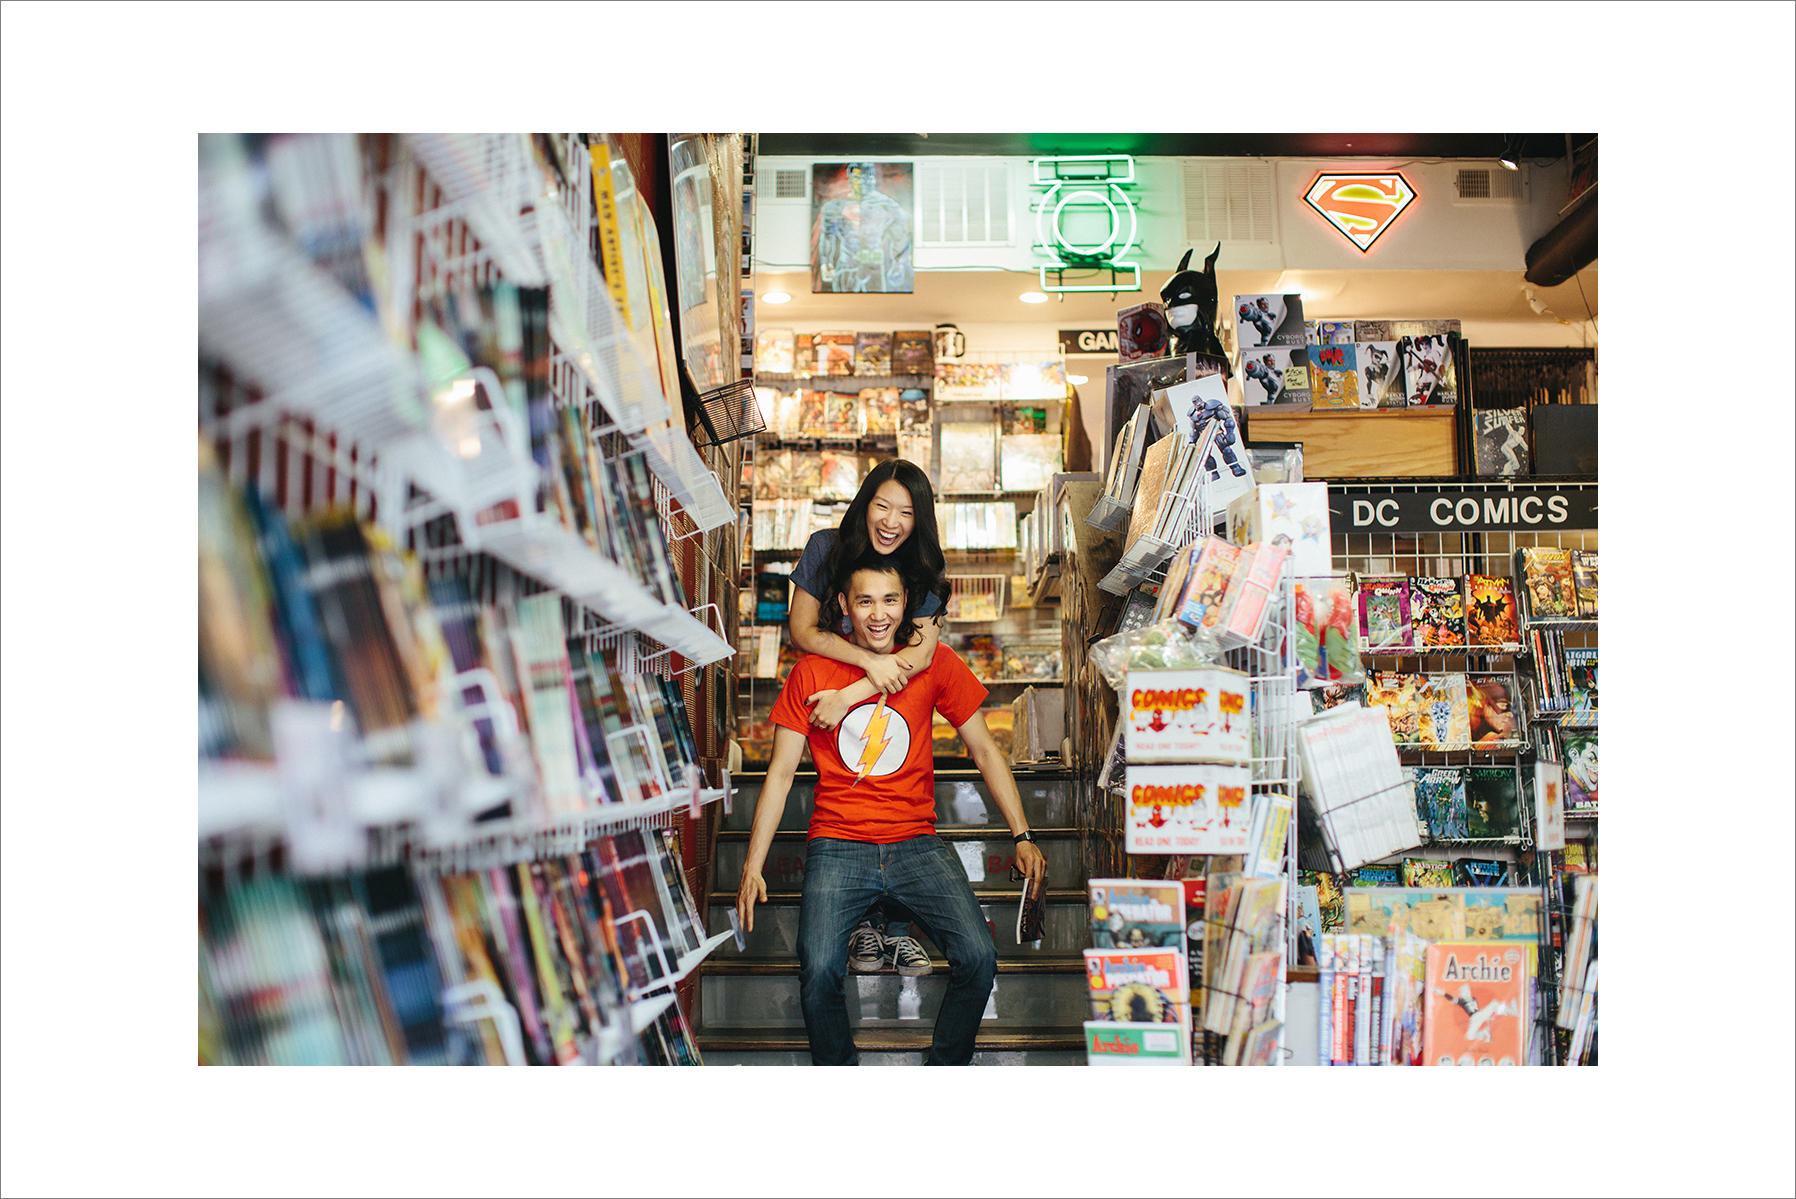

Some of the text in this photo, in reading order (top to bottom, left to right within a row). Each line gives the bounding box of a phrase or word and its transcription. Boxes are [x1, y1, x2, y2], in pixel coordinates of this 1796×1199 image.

[1485, 408, 1524, 419] SILVER
[1482, 416, 1526, 436] SURFER
[1353, 495, 1569, 526] DC COMICS
[1428, 584, 1455, 592] QUINN
[1473, 576, 1510, 587] BATMAN
[1374, 588, 1402, 597] QUINN
[1476, 675, 1511, 684] FLASH
[1132, 688, 1208, 710] COMICS
[1419, 773, 1461, 784] ARROW
[1432, 769, 1460, 777] GREEN
[1475, 769, 1512, 778] ARROW
[1132, 784, 1207, 807] COMICS
[1135, 837, 1153, 846] READ
[1157, 837, 1171, 846] ONE
[1359, 875, 1398, 883] PEOPLE
[1108, 888, 1150, 904] Archie
[1104, 957, 1146, 973] Archie
[1443, 953, 1512, 982] Archie
[1322, 998, 1330, 1014] THE
[1335, 996, 1343, 1009] THE
[1372, 997, 1380, 1011] THE
[1321, 1015, 1330, 1055] MARRIED
[1092, 1035, 1139, 1054] Archie
